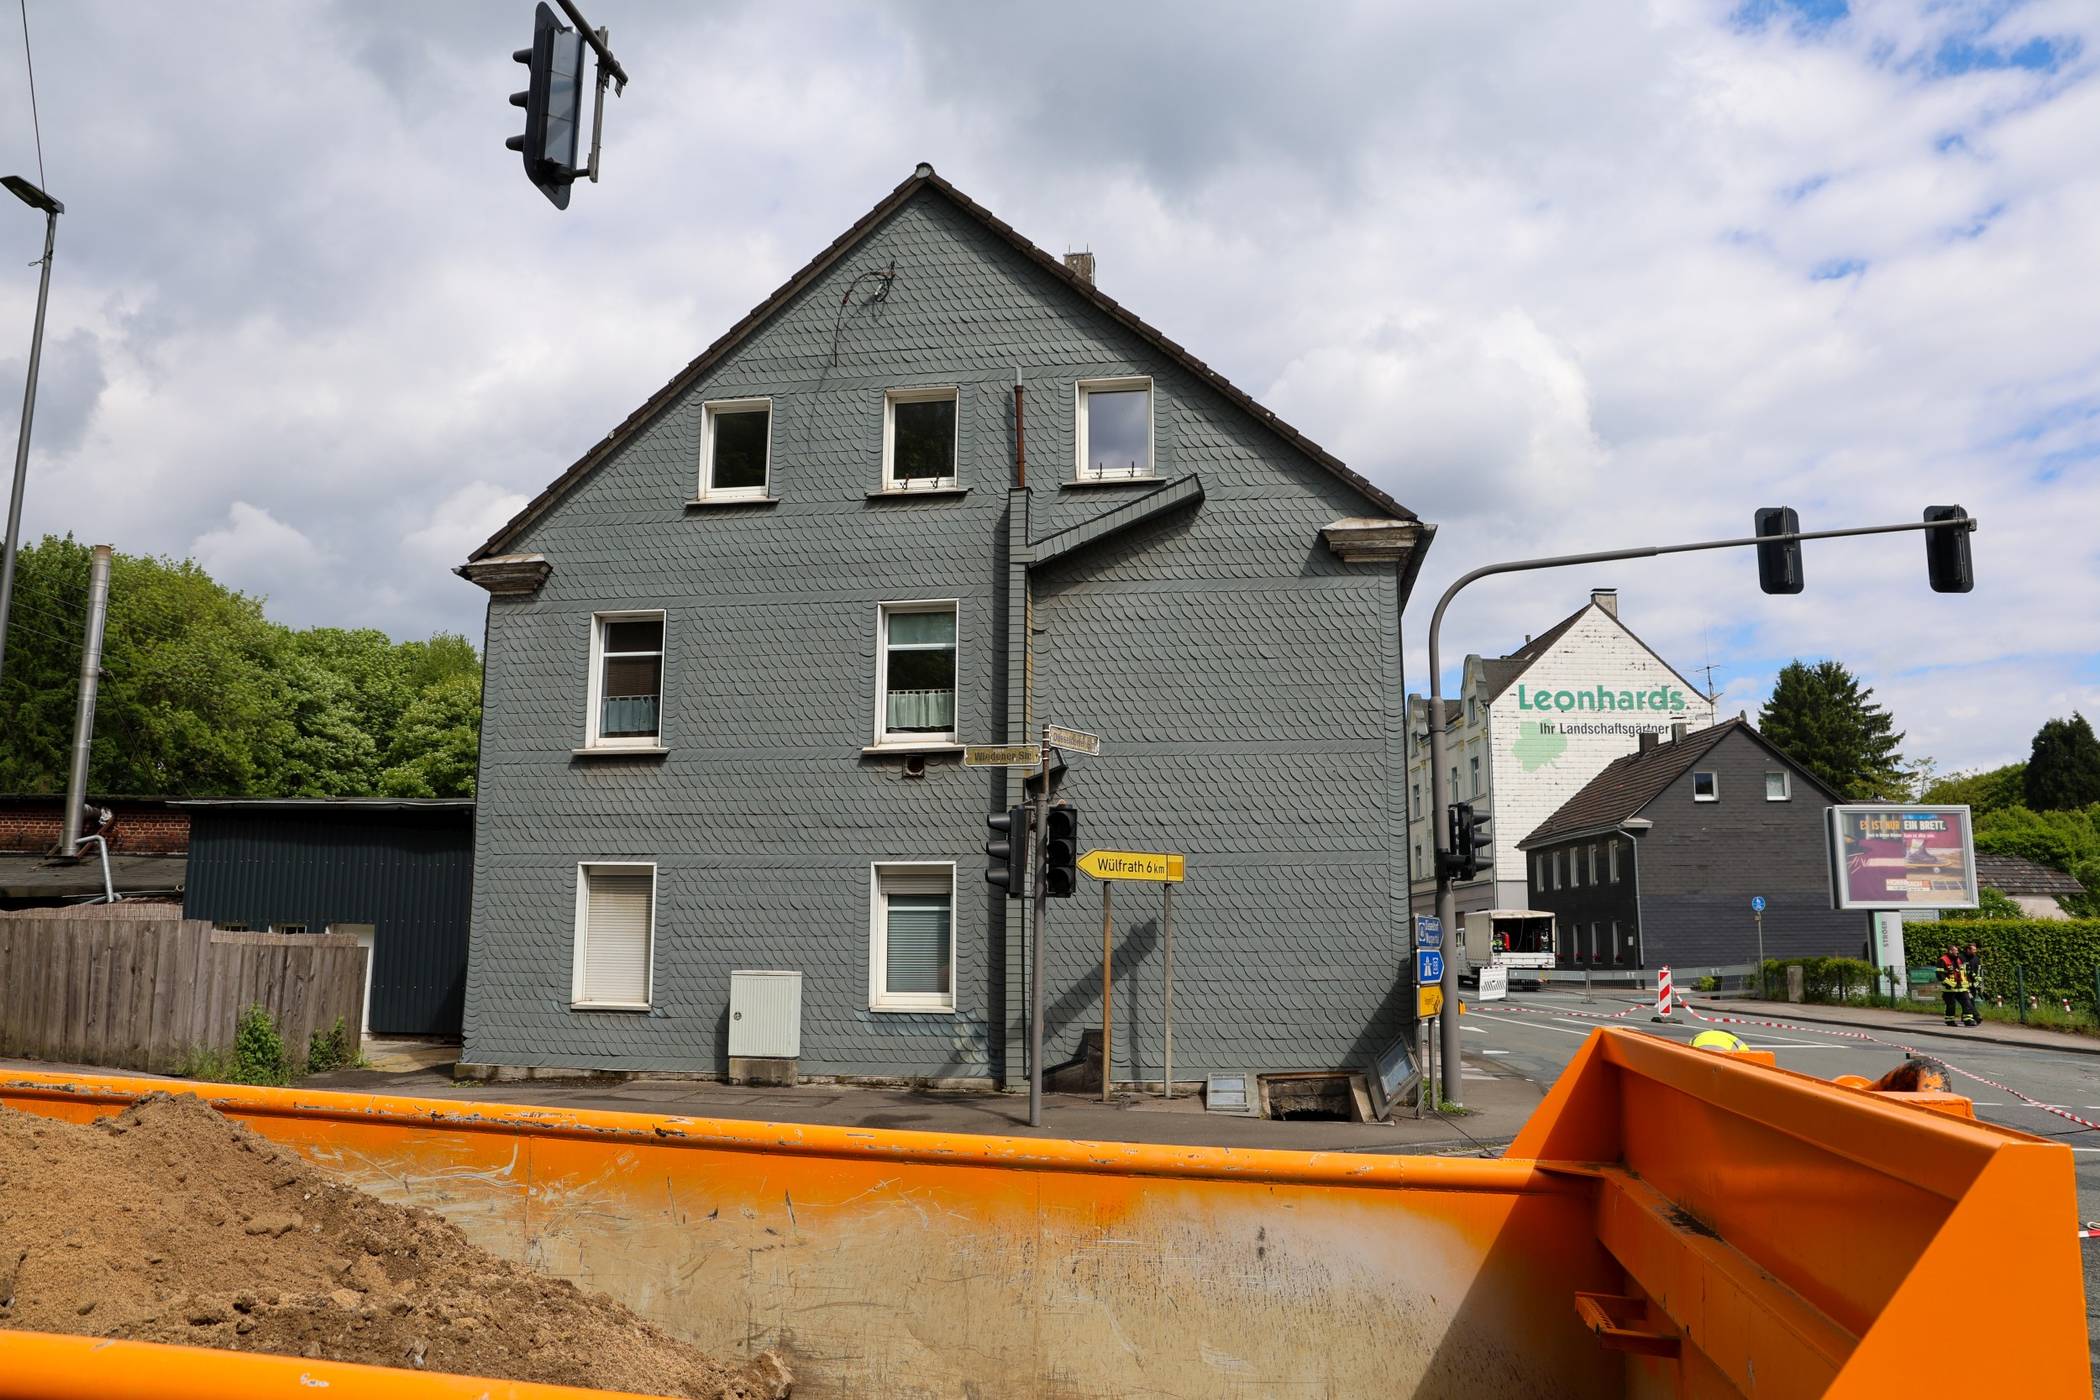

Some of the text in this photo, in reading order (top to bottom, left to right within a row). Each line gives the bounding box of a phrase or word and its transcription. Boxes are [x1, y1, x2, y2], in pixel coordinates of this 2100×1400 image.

[1518, 684, 1686, 711] Leonhards
[1540, 722, 1669, 737] Ihr Landschaftsgärtner
[1097, 857, 1165, 874] Wülfrath 6 km
